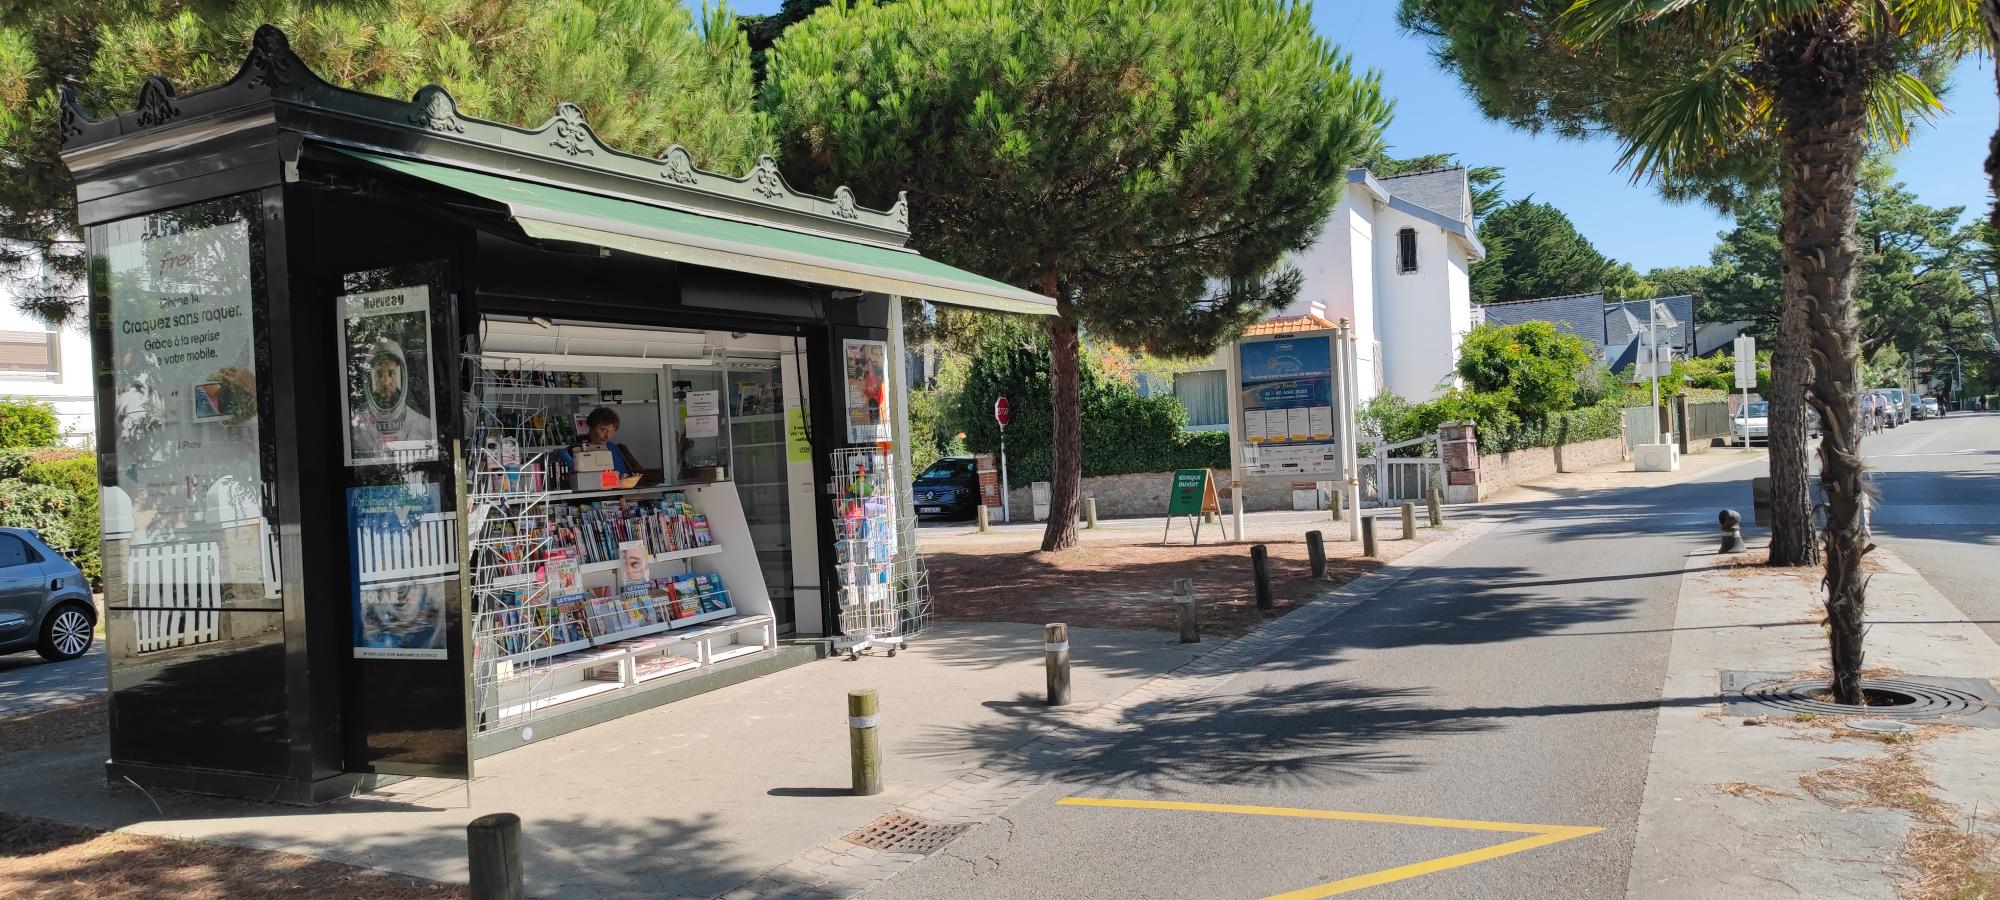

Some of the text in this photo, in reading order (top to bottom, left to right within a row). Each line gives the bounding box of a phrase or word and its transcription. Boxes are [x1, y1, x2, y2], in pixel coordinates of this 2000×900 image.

[122, 305, 242, 335] Craquez sans raquer.
[144, 330, 220, 351] Grâce à la reprise
[164, 352, 185, 364] votre
[187, 348, 218, 362] mobile.
[998, 407, 1009, 416] STOP
